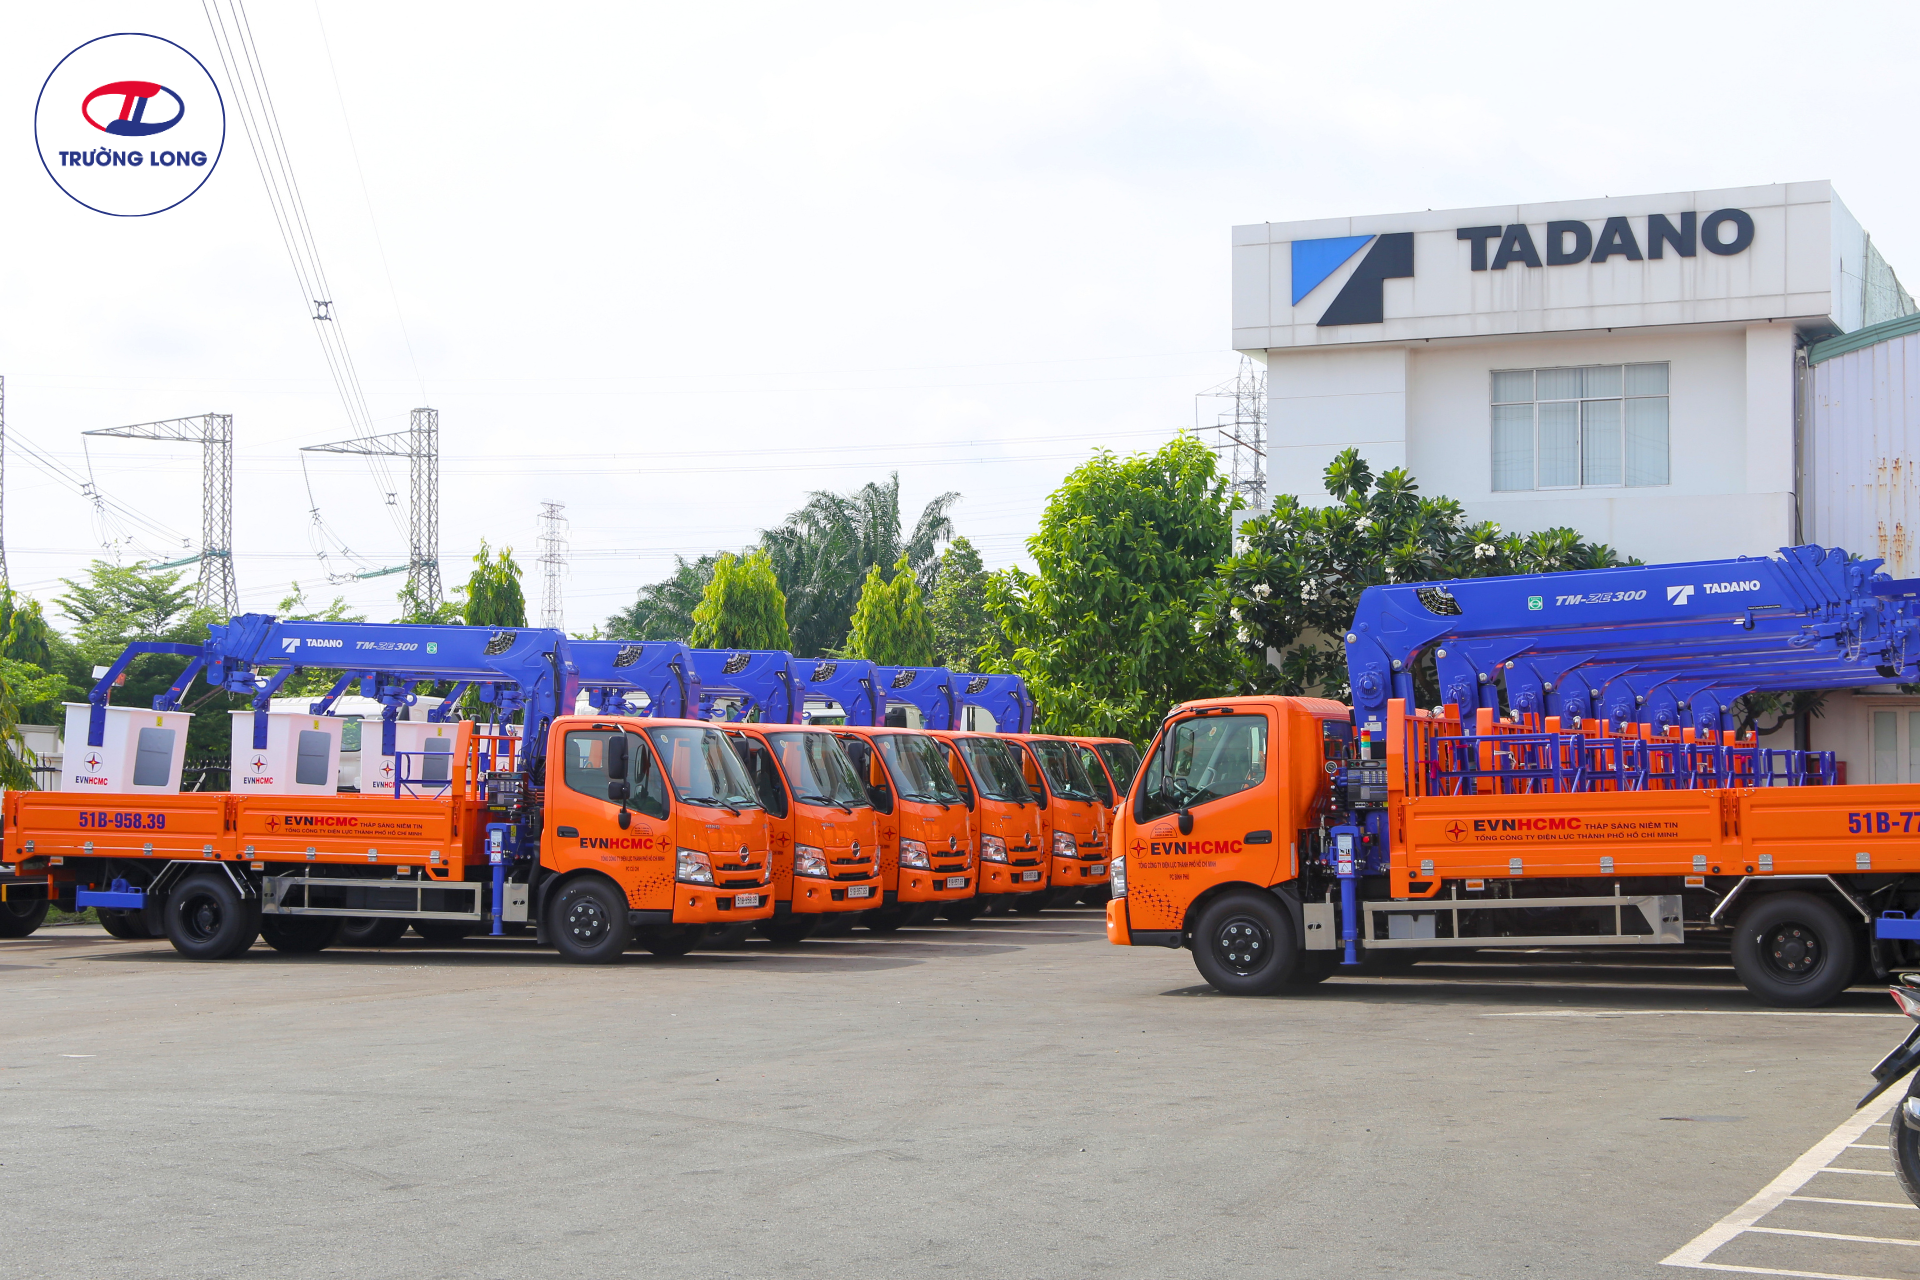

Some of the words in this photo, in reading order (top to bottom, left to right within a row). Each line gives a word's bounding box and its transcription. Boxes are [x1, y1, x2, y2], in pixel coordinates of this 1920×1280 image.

[1457, 208, 1755, 272] TADANO
[1703, 580, 1761, 595] TADANO
[306, 638, 343, 648] TADANO
[75, 775, 109, 786] EVNHCMC
[243, 776, 274, 785] EVNHCMC
[372, 781, 401, 789] EVNHC
[79, 811, 166, 830] 51B-958.39
[284, 815, 358, 827] EVNHCMC
[1473, 817, 1582, 832] EVNHCMC
[1610, 821, 1637, 830] SÁNG
[579, 837, 654, 850] EVNHCMC
[1150, 840, 1243, 856] EVNHCMC
